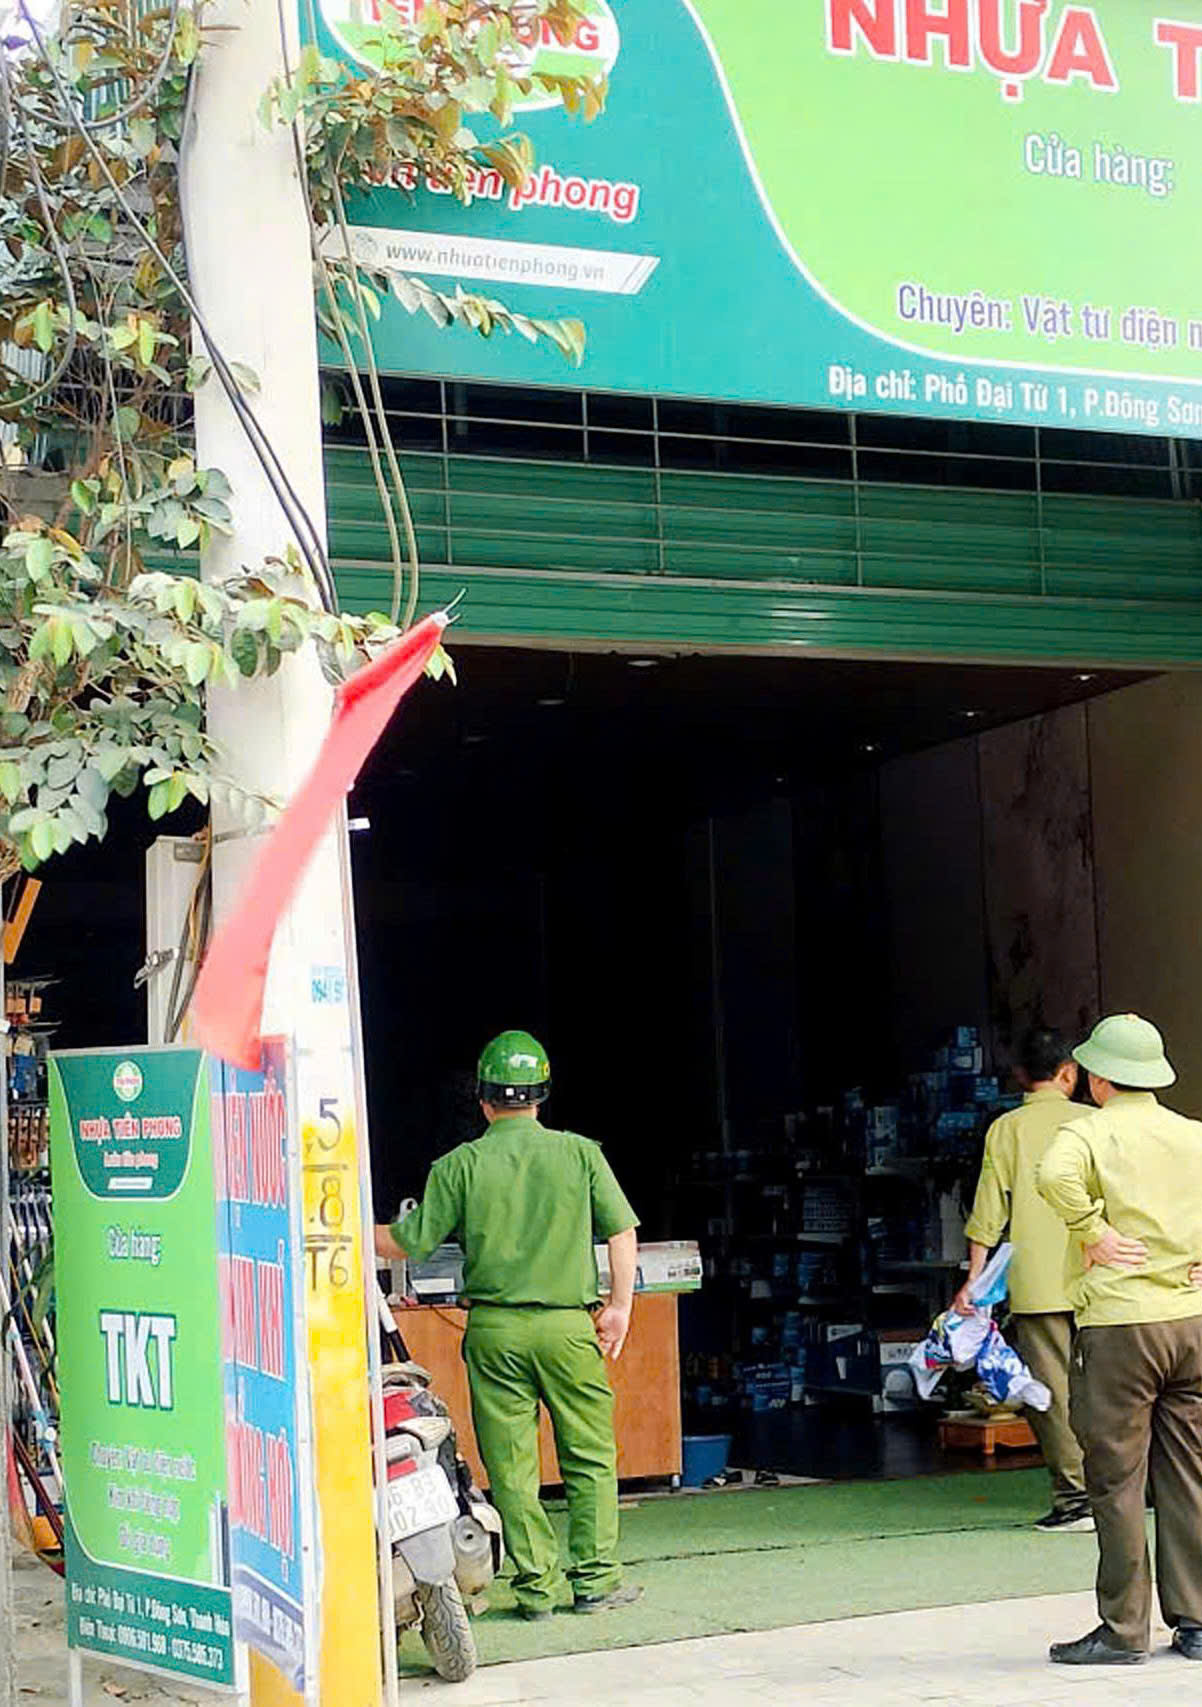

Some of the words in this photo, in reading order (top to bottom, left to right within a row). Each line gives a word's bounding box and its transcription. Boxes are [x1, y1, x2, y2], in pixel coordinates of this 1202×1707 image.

[829, 0, 1117, 99] NHỰA
[511, 166, 637, 221] phong
[1025, 132, 1082, 180] Cửa
[1093, 143, 1175, 197] hàng:
[898, 284, 1012, 333] Chuyên:
[1022, 296, 1071, 341] Vật
[1082, 305, 1112, 339] tư
[1122, 308, 1177, 351] điện
[828, 365, 868, 401] Địa
[924, 373, 968, 406] Phố
[975, 377, 1014, 413] Đại
[1058, 386, 1078, 419] 1,
[1084, 388, 1161, 428] P.Đông
[100, 1311, 176, 1409] TKT
